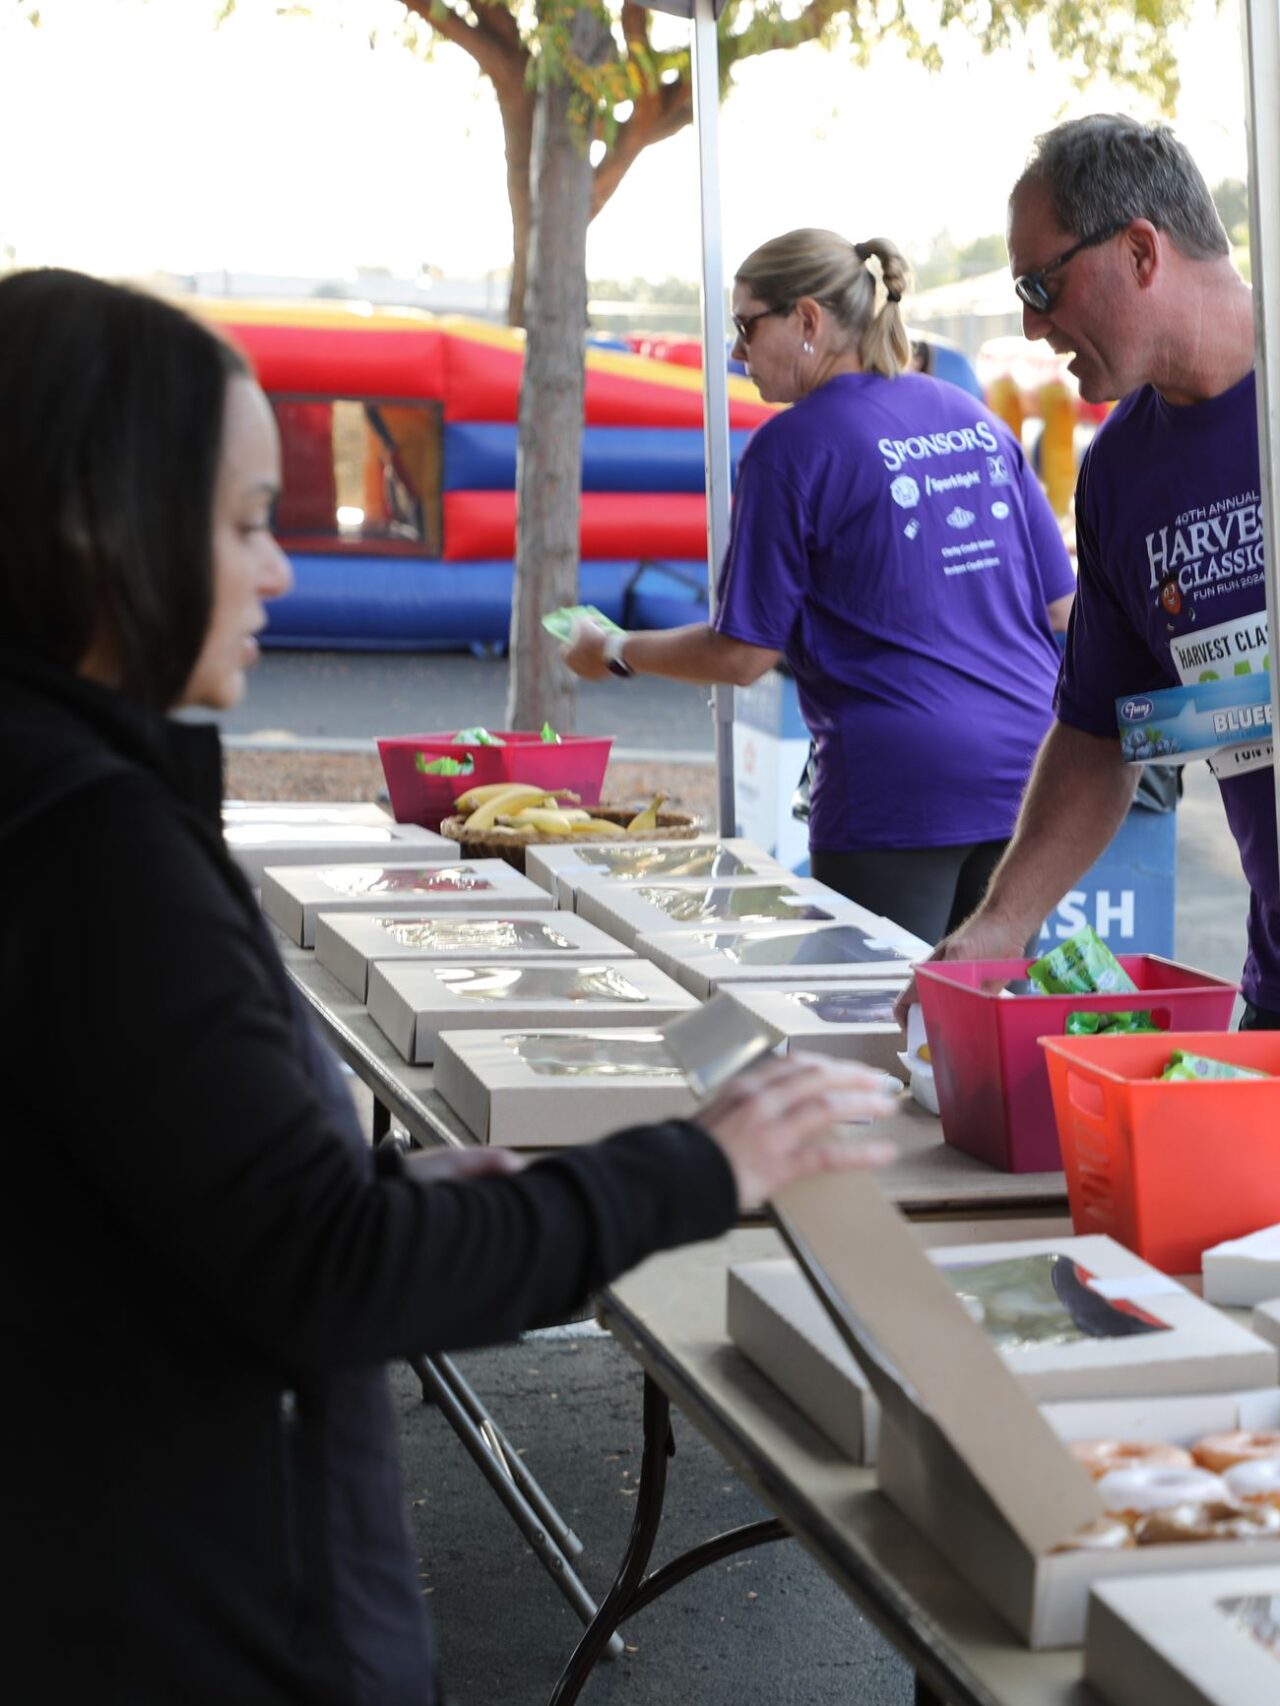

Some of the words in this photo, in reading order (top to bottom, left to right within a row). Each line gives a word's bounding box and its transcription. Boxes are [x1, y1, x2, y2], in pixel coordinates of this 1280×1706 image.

[878, 421, 998, 472] SPONSORS
[1175, 506, 1206, 527] 40TH
[1208, 490, 1259, 517] ANNUAL
[1193, 587, 1215, 602] FUN
[1216, 580, 1240, 594] RUN
[1178, 635, 1231, 670] HARVEST
[1040, 889, 1135, 940] SH
